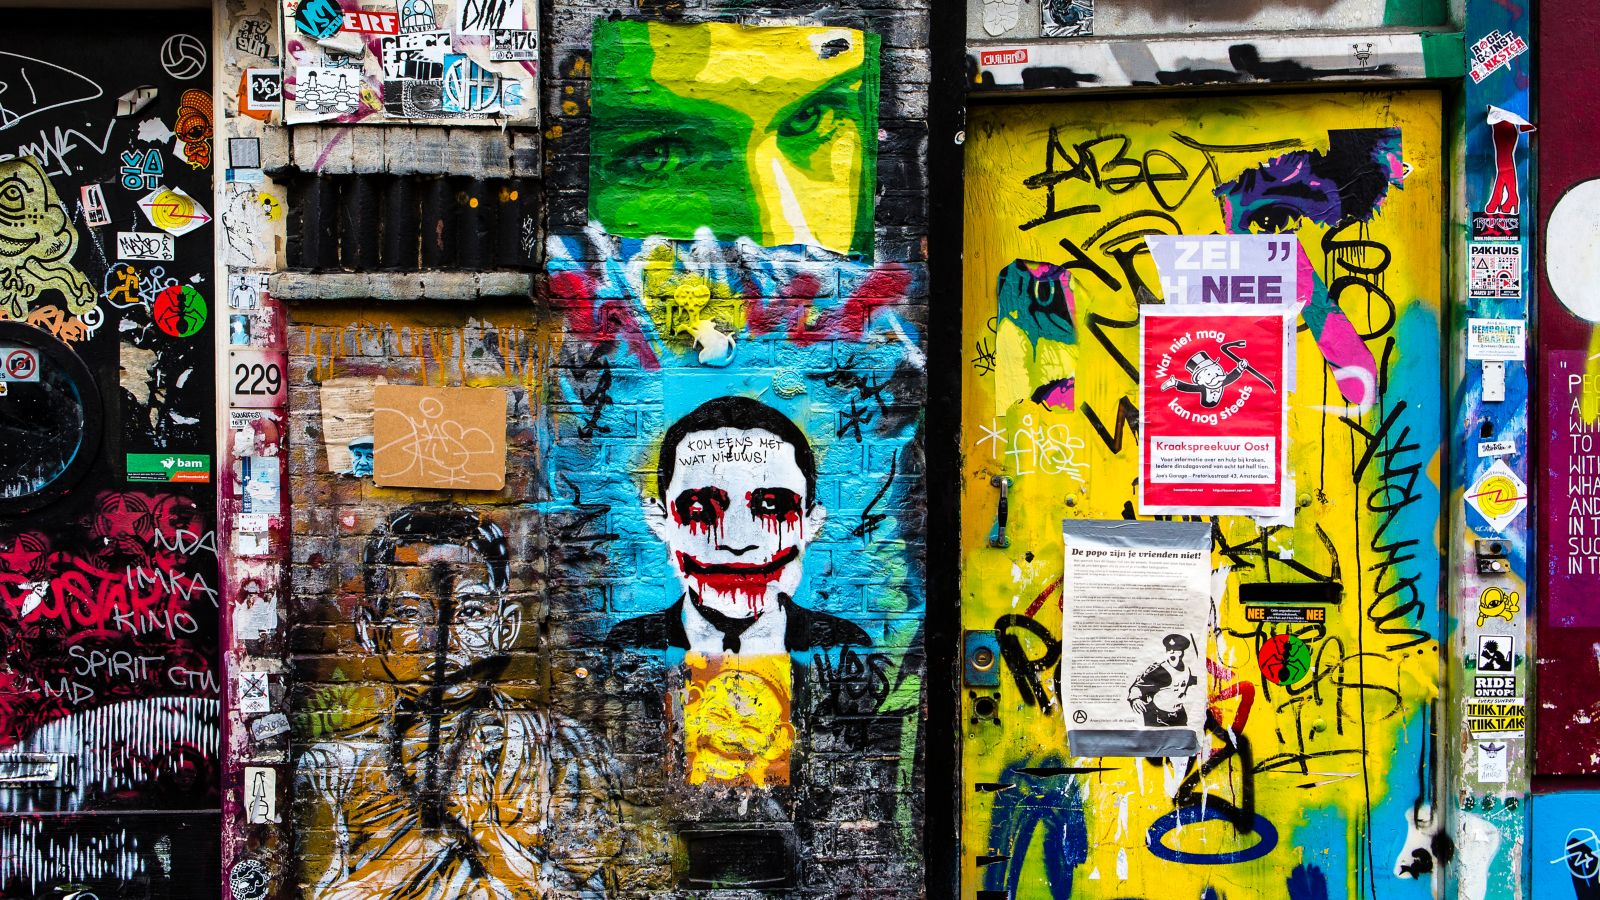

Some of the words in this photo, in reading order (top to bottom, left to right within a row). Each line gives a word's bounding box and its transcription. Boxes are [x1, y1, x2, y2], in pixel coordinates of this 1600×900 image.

[1174, 241, 1240, 270] ZEI
[1471, 246, 1519, 255] PAKHUIS
[1202, 276, 1282, 304] NEE
[1155, 354, 1172, 378] Wat
[1170, 332, 1192, 353] niet
[1196, 330, 1225, 343] mag
[235, 363, 281, 395] 229
[1168, 398, 1191, 419] kan
[1192, 413, 1218, 425] nog
[1220, 385, 1253, 419] steeds
[688, 439, 712, 451] KOM
[717, 437, 753, 449] EENS
[760, 438, 784, 451] MET
[1156, 441, 1240, 453] Kraakspreekuur
[1244, 441, 1269, 451] Oost
[177, 458, 203, 468] bam
[679, 454, 706, 466] WAT
[1072, 548, 1083, 556] De
[1085, 549, 1107, 558] popo
[1109, 550, 1126, 558] zijn
[1128, 550, 1137, 558] je
[1138, 551, 1178, 559] vrienden
[1180, 552, 1201, 560] niet!
[1247, 608, 1265, 620] NEE
[1306, 609, 1324, 621] NEE
[113, 603, 198, 640] KIMO
[1475, 677, 1514, 688] RIDE
